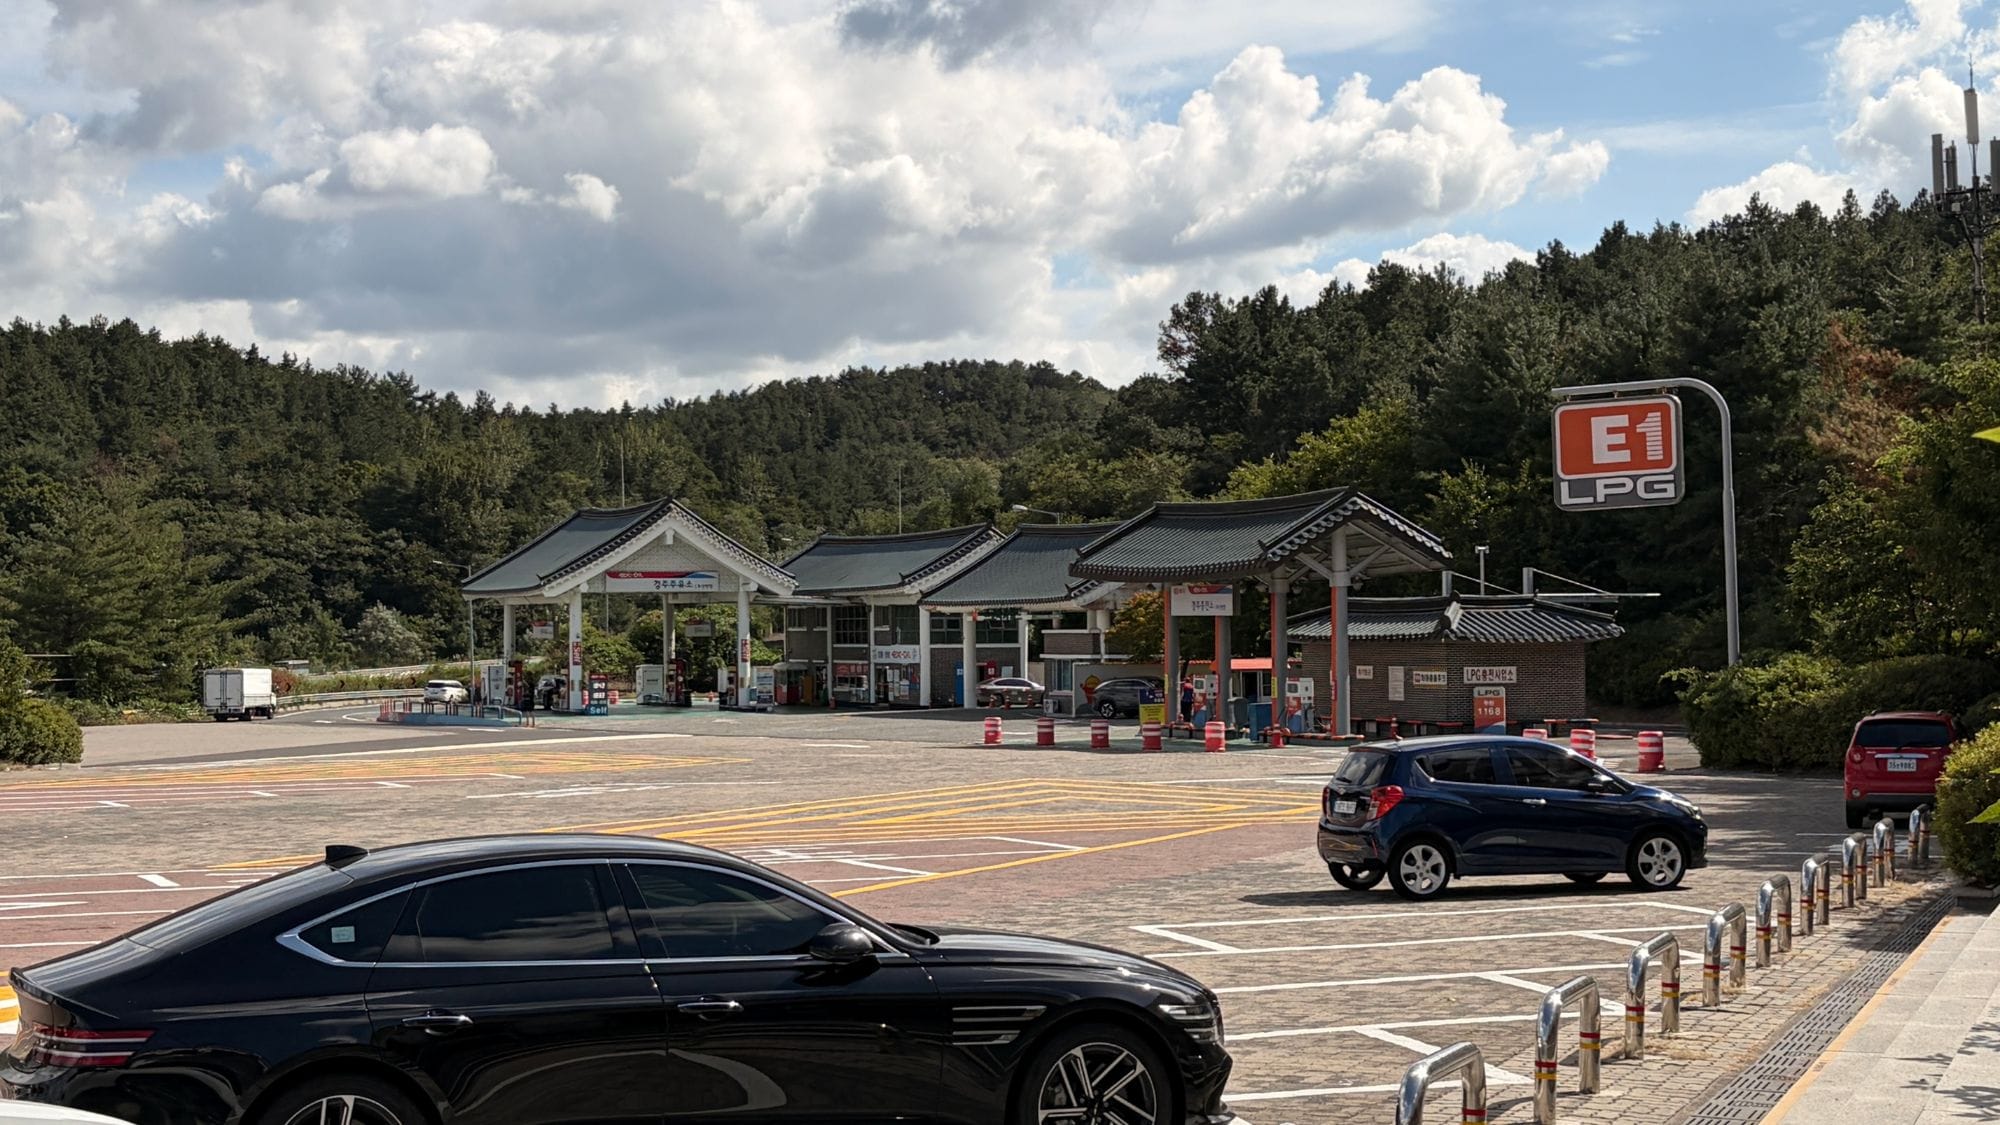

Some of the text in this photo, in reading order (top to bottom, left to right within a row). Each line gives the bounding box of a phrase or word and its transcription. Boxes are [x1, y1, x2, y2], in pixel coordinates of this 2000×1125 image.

[1590, 411, 1664, 465] E1
[1560, 474, 1676, 505] LPG
[1466, 669, 1514, 682] LPG충전사업소
[590, 705, 607, 715] Self
[1478, 707, 1501, 715] 1168
